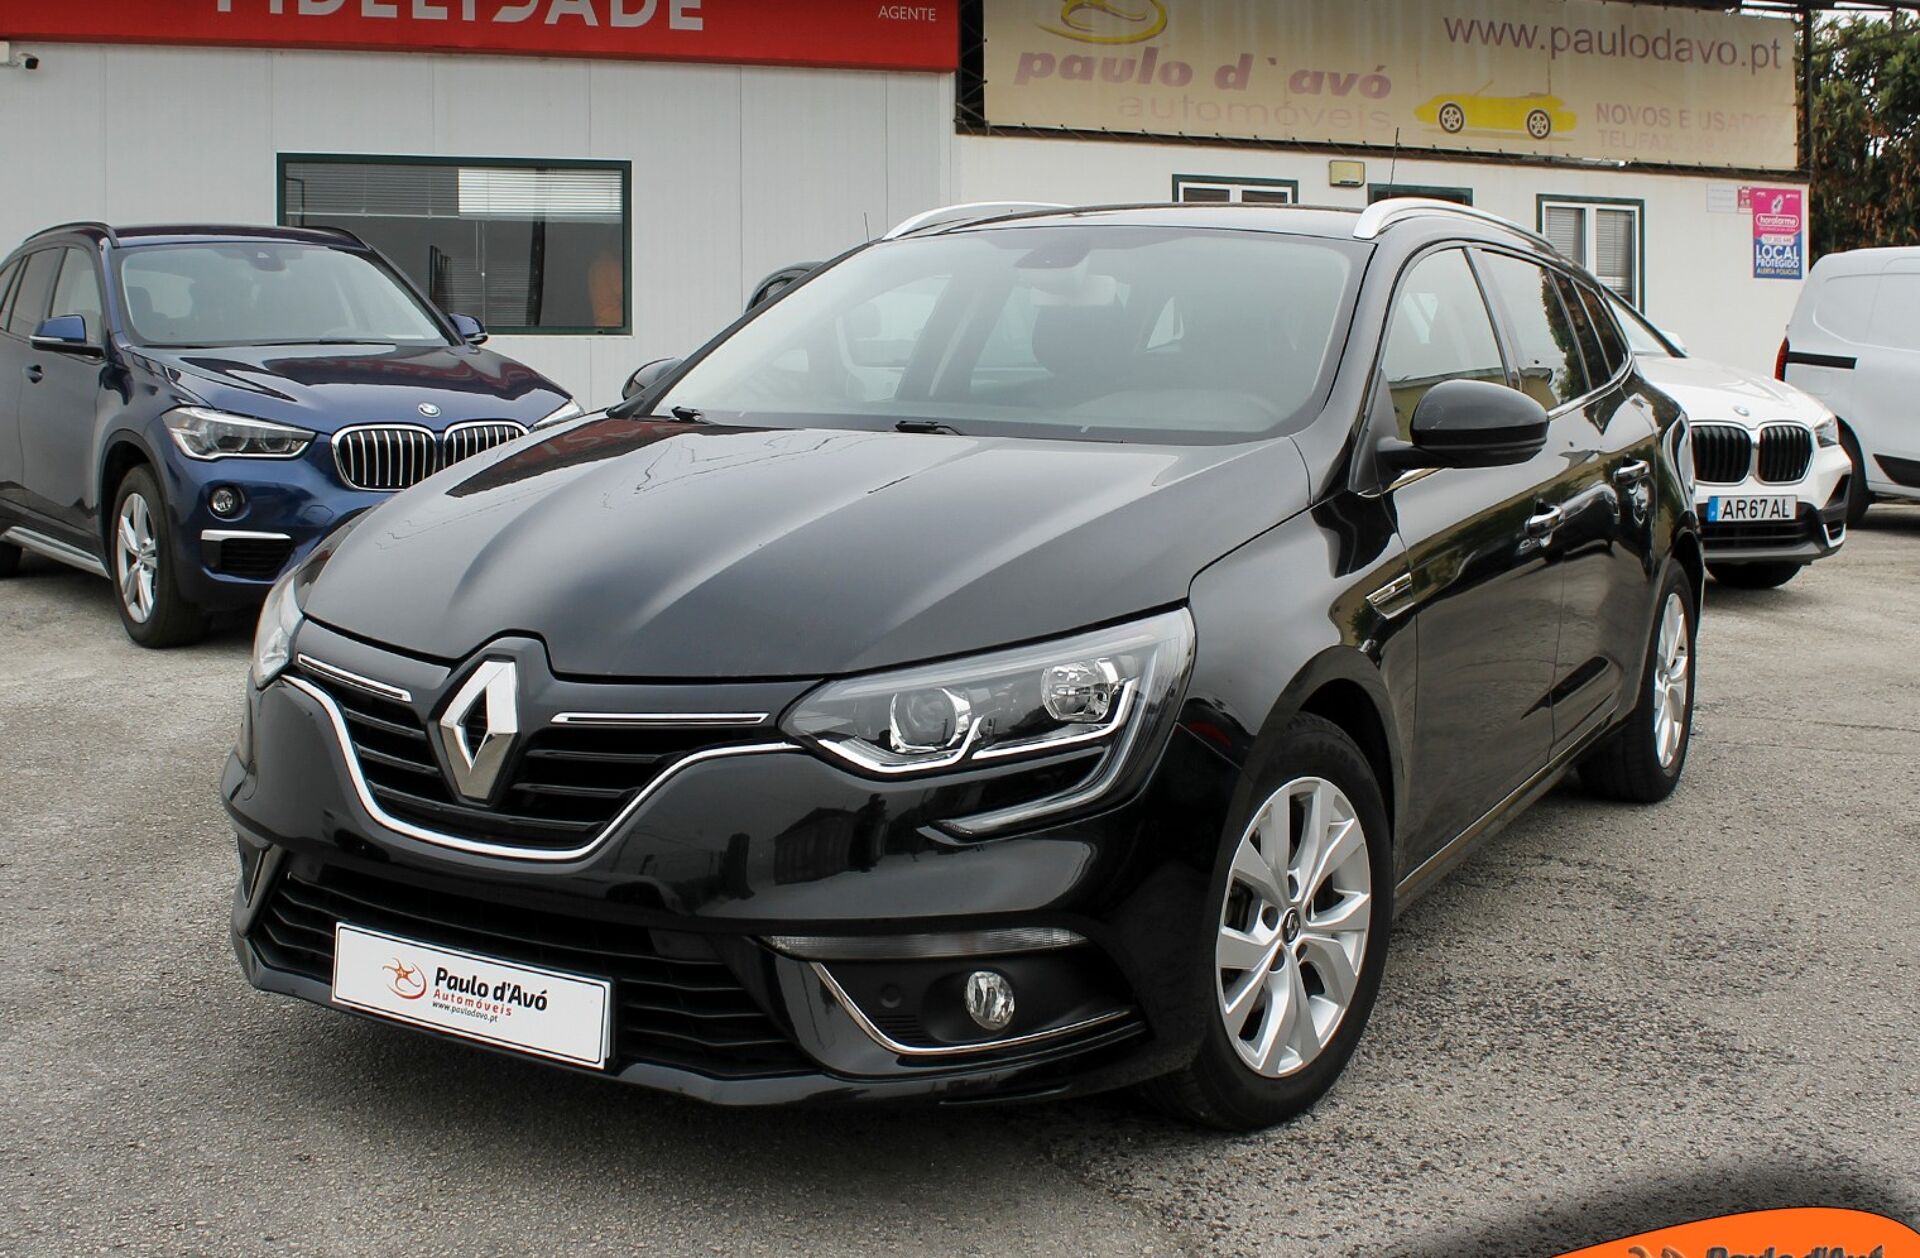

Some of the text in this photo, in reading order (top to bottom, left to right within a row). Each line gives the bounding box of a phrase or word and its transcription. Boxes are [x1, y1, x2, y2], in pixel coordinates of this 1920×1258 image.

[878, 5, 937, 21] AGENTE
[1444, 16, 1782, 75] www.paulodavo.pt
[1013, 46, 1193, 86] paulo
[1118, 94, 1392, 132] automóveis
[1596, 103, 1671, 127] NOVOS
[1756, 245, 1800, 261] LOCAL
[1756, 258, 1800, 269] PROTEGIDO
[433, 988, 513, 1017] Automóveis
[434, 967, 548, 1012] Paulo d'Avó
[432, 1001, 499, 1023] www.paulodavo.pt
